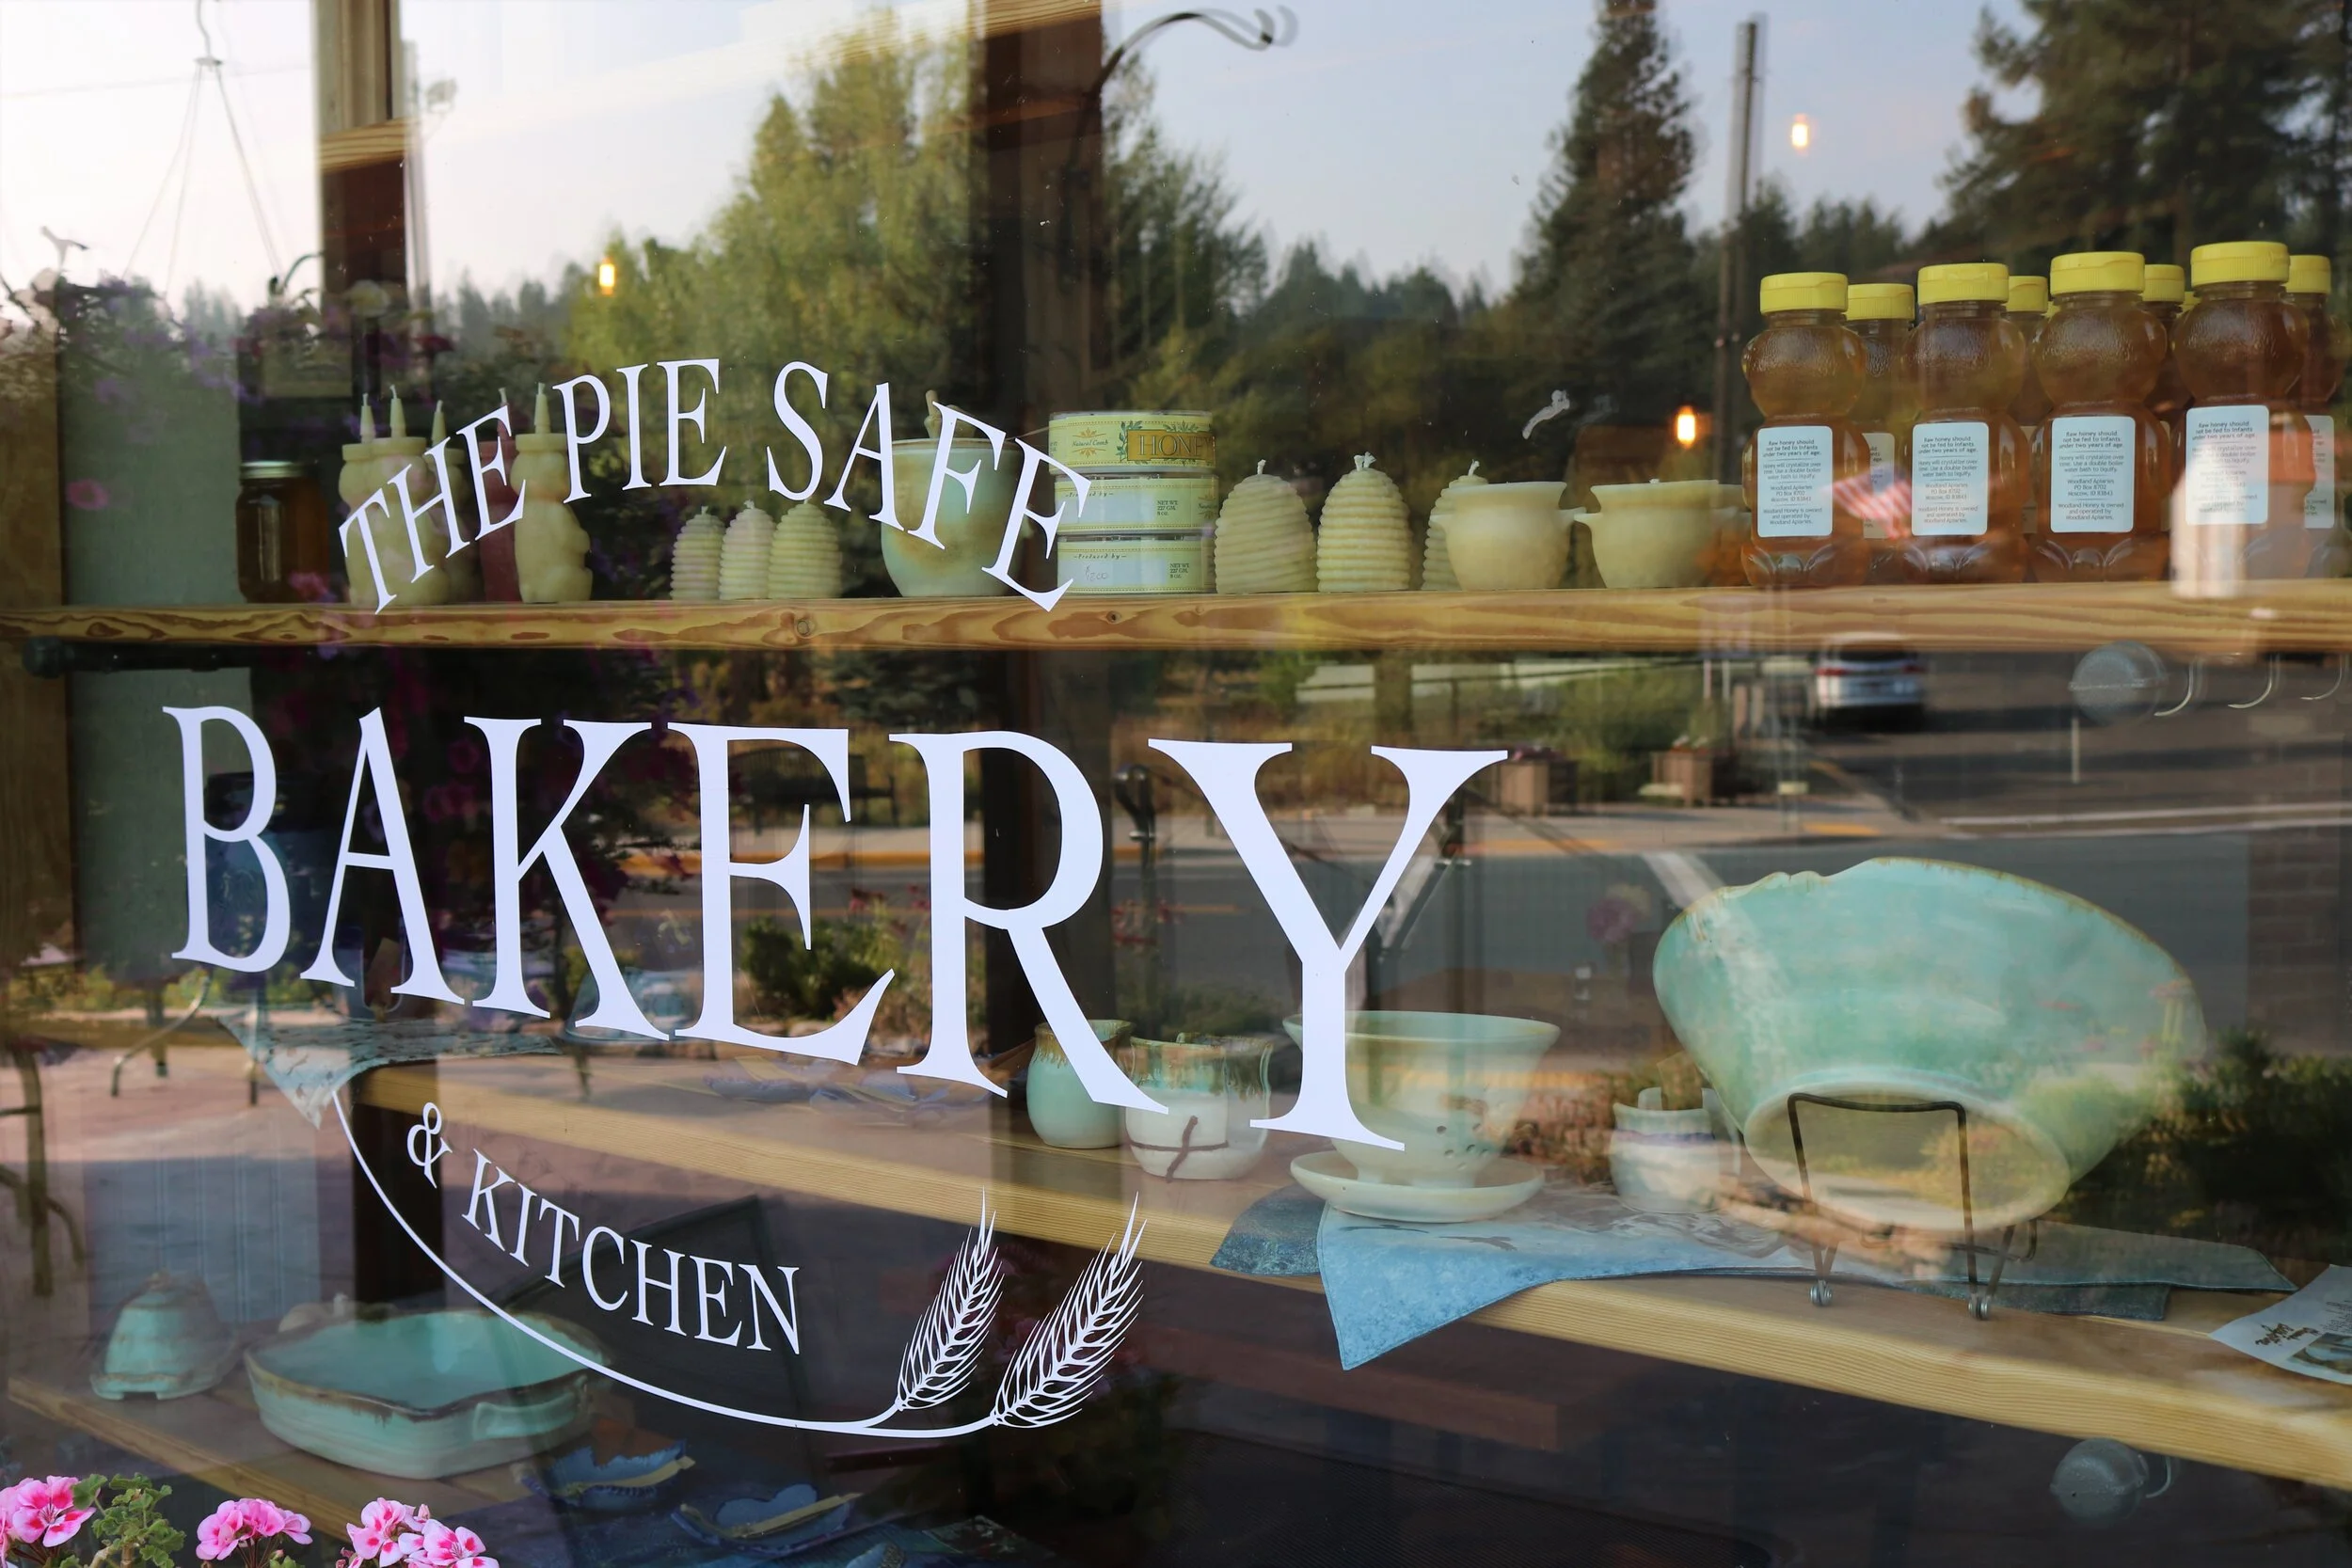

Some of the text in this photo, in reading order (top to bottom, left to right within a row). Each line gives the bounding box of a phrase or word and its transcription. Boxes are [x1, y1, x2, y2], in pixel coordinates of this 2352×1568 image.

[339, 359, 1091, 614] THE PIE SAFE
[164, 707, 1508, 1152] BAKERY
[407, 1102, 800, 1354] & KITCHEN
